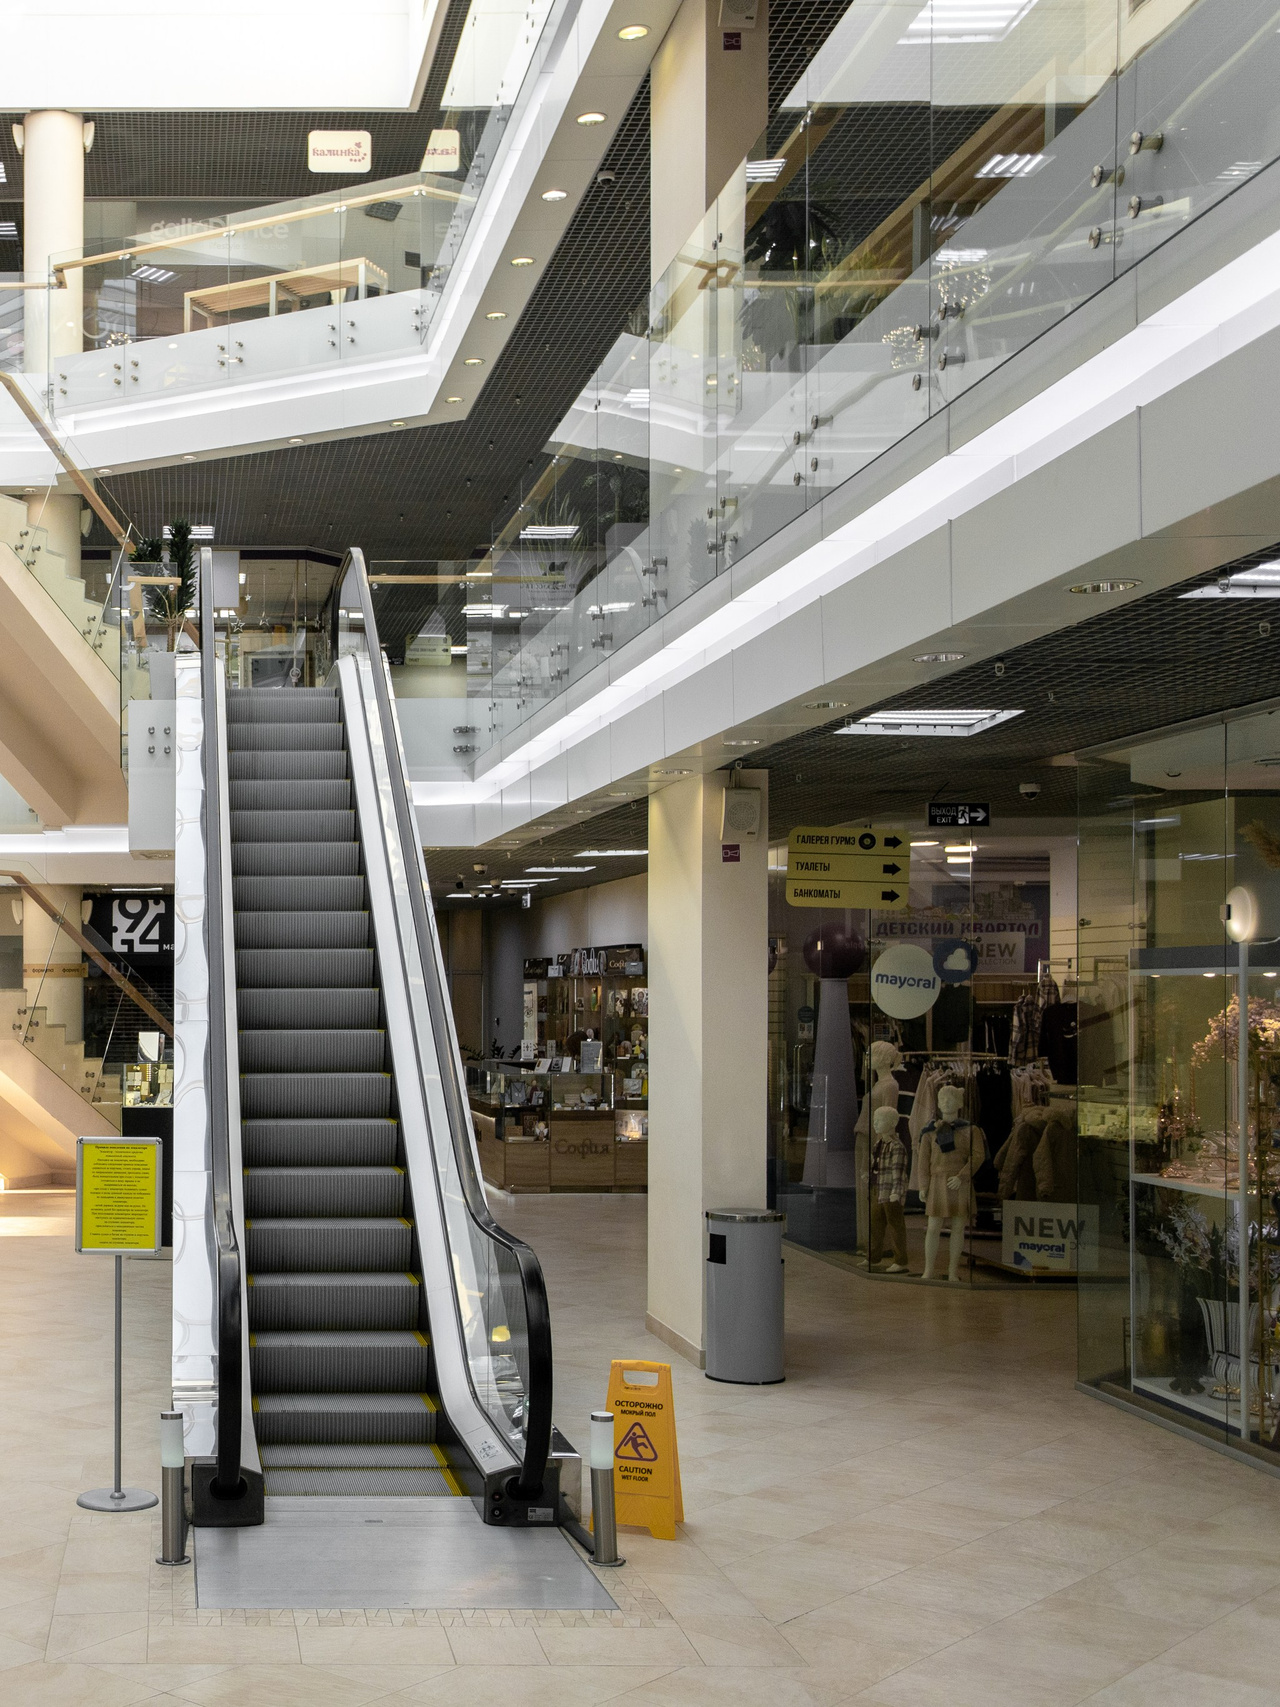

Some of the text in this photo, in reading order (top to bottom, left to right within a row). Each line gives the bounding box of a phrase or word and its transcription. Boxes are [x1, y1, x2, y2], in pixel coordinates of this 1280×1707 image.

[931, 806, 957, 816] ВЫХОД
[796, 835, 856, 846] ГАЛЕРЕЯ ГУРМЭ
[795, 861, 830, 872] ТУАЛЕТЫ
[793, 888, 841, 899] БАНКОМАТЫ
[876, 920, 954, 936] ДЕТСКИЙ
[875, 973, 936, 990] mayoral
[1014, 1216, 1086, 1240] NEW
[1019, 1242, 1065, 1253] mayoral
[614, 1400, 663, 1411] ОСТОРОЖНО
[620, 1409, 644, 1417] МОКРЫЙ
[619, 1465, 652, 1475] CAUTION
